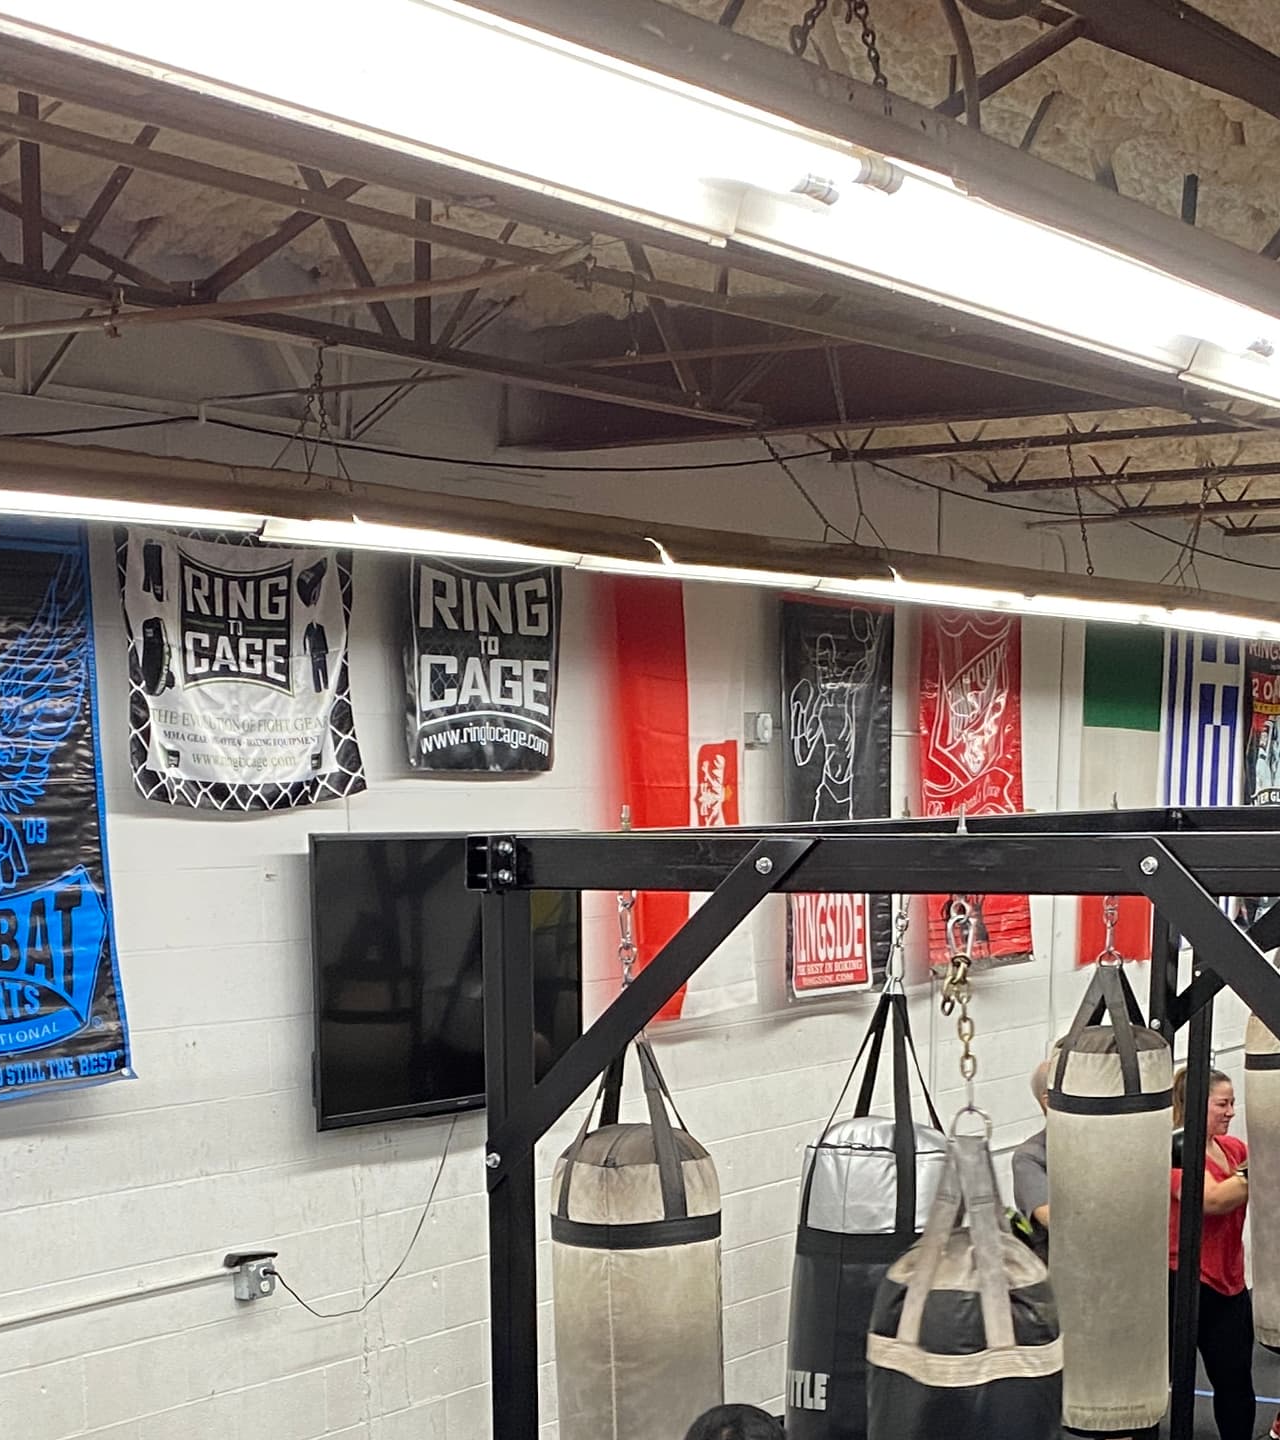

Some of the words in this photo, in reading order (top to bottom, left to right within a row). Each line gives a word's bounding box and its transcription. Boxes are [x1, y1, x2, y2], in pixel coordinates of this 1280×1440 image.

[184, 564, 288, 621] RING
[419, 564, 549, 637] RING
[184, 631, 287, 682] CAGE
[479, 635, 499, 655] TO
[421, 654, 550, 716] CAGE
[420, 722, 549, 757] www.ringtocage.com
[6, 1063, 47, 1086] STILL
[48, 1057, 76, 1079] THE
[78, 1051, 118, 1075] BEST
